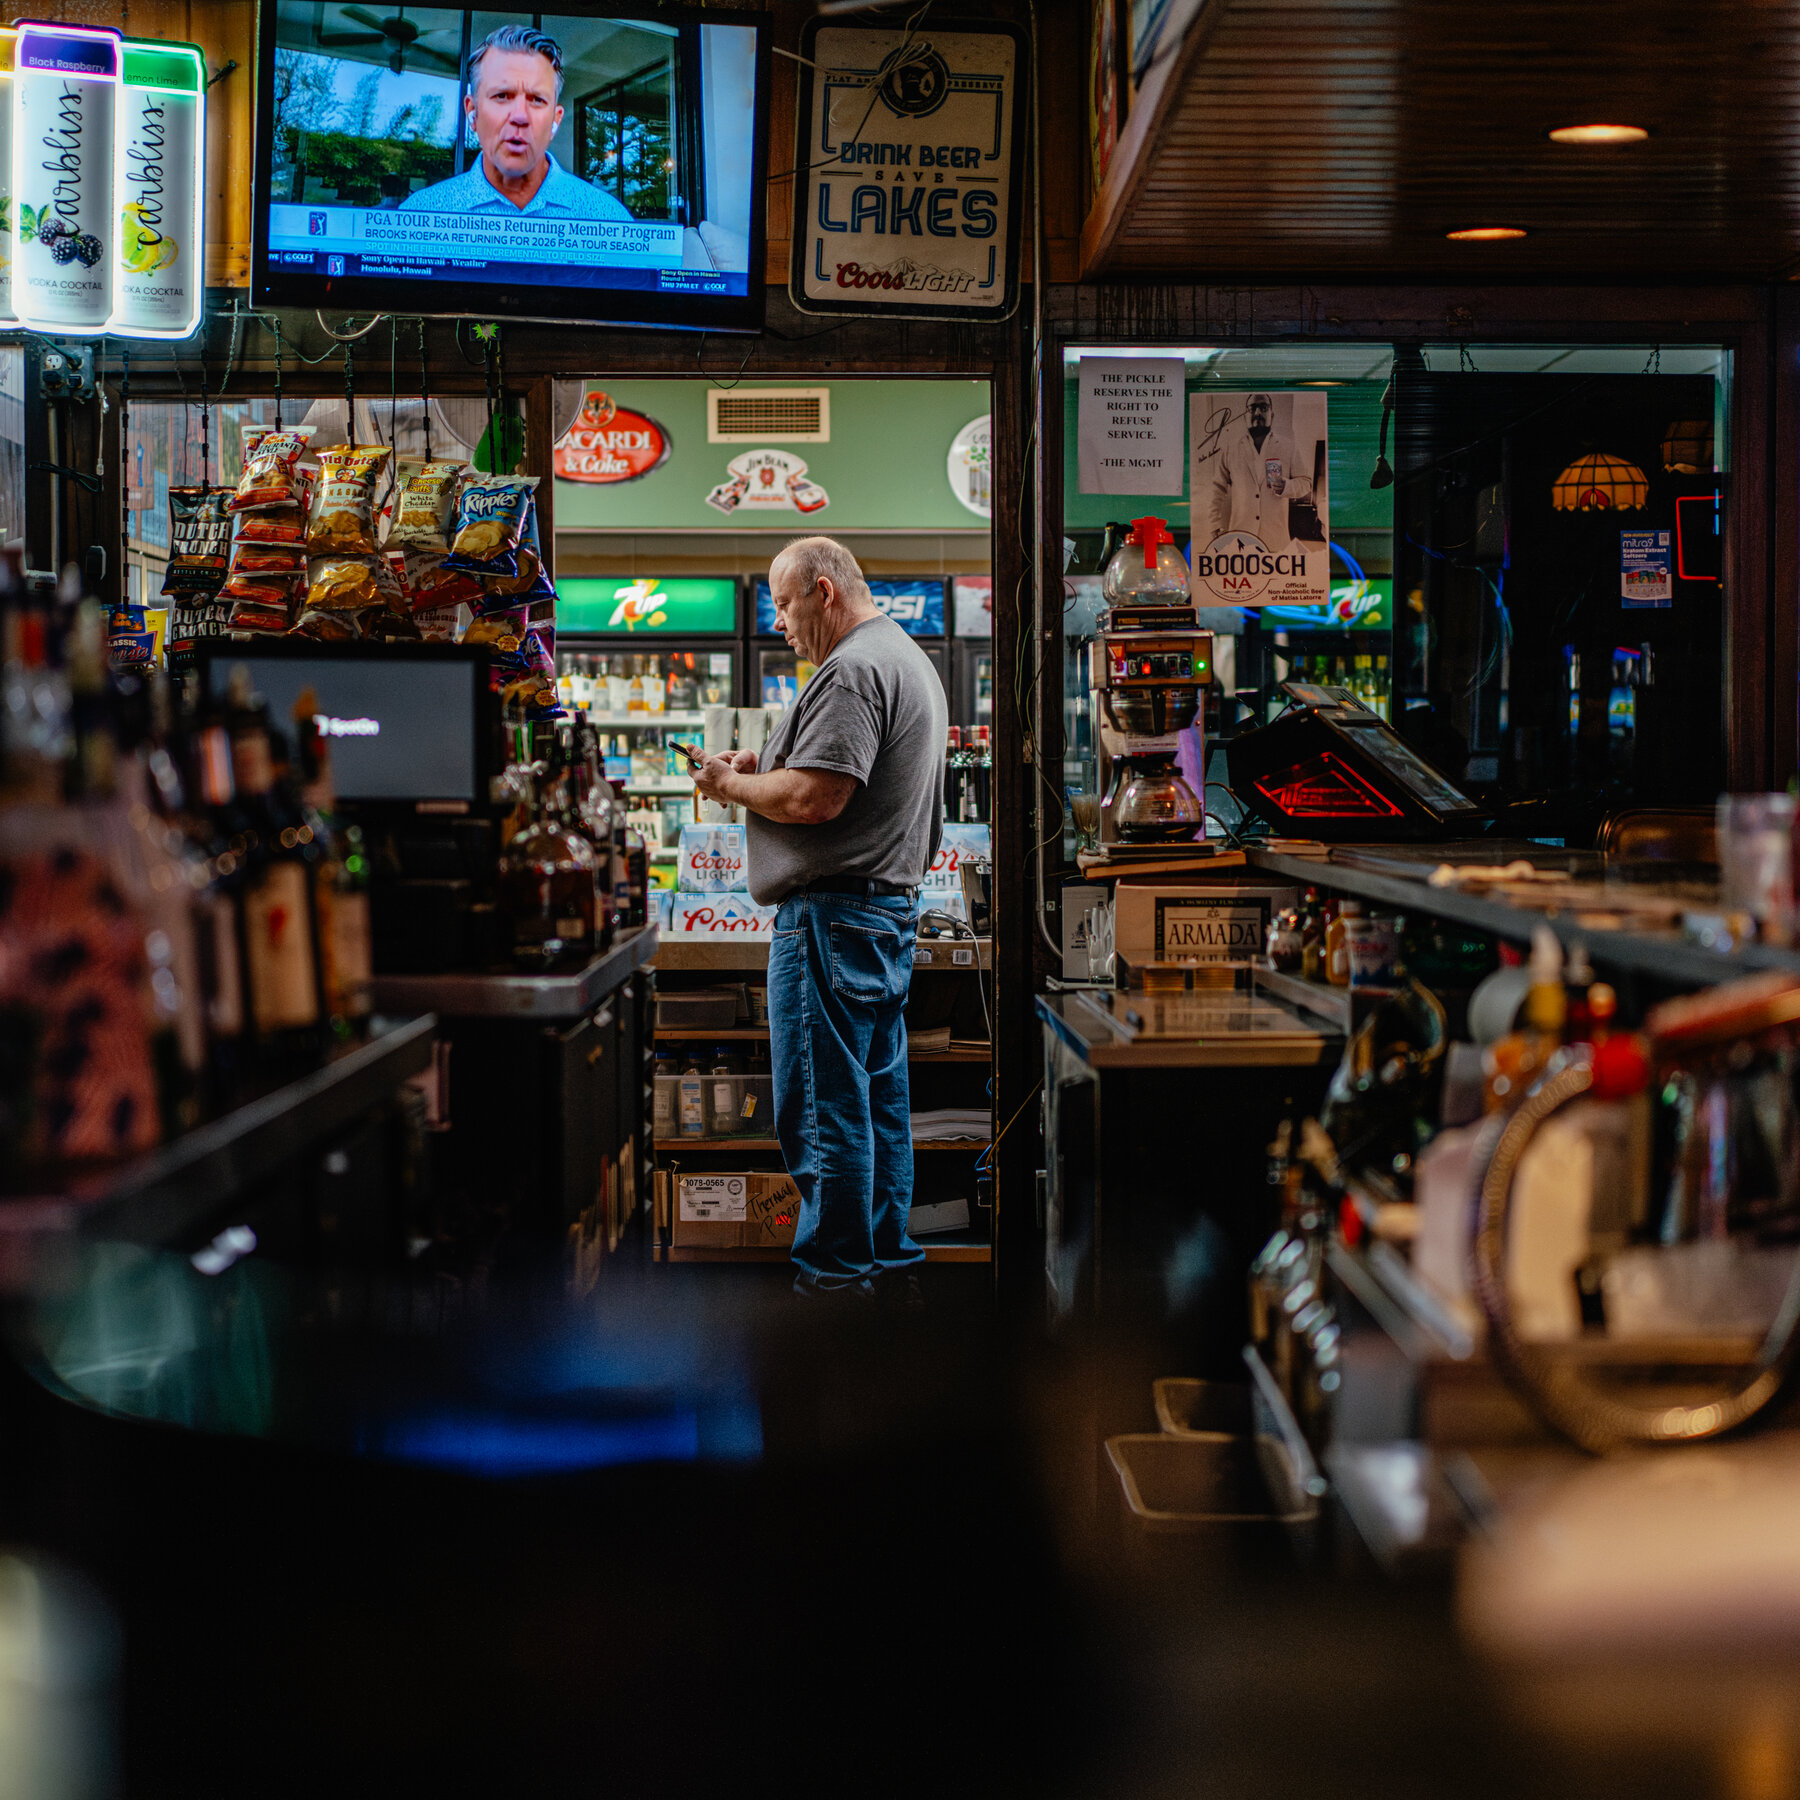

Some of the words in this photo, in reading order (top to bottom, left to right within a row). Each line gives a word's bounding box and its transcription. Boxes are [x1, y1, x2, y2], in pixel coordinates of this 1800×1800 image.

[29, 56, 54, 68] Black
[56, 58, 106, 74] Raspberry
[156, 76, 178, 86] Lime
[840, 142, 912, 167] DRINK
[919, 146, 980, 168] BEER
[875, 170, 944, 184] SAVE
[818, 182, 998, 238] LAKES
[365, 212, 392, 225] PGA
[395, 214, 430, 227] TOUR
[434, 215, 501, 231] Establishes
[504, 219, 566, 237] Returning
[568, 223, 620, 238] Member
[622, 226, 676, 242] Program
[365, 229, 407, 239] BROOKS
[410, 231, 450, 241] KOEPKA
[451, 233, 508, 244] RETURNING
[510, 237, 529, 246] FOR
[532, 237, 556, 247] 2026
[558, 239, 578, 249] PGA
[581, 240, 608, 250] TOUR
[610, 242, 650, 252] SEASON
[361, 254, 381, 264] Sony
[383, 255, 405, 264] Open
[416, 257, 445, 265] Hawaii
[452, 258, 488, 268] Weather
[366, 242, 389, 251] SPOT
[391, 243, 400, 251] IN
[401, 243, 419, 252] THE
[421, 244, 444, 253] FIELD
[446, 246, 470, 255] WILL
[471, 247, 482, 255] BE
[484, 248, 546, 259] INCREMENTAL
[547, 251, 558, 259] TO
[560, 252, 585, 260] FIELD
[586, 253, 605, 262] SIZE
[361, 264, 401, 274] Honolulu,
[403, 266, 432, 275] Hawaii
[836, 262, 905, 290] Coors
[903, 270, 976, 293] LIGHT
[60, 280, 103, 291] COCKTAIL
[143, 286, 184, 297] COCKTAIL
[1101, 374, 1123, 383] THE
[1126, 374, 1166, 384] PICKLE
[1094, 388, 1148, 397] RESERVES
[1151, 388, 1172, 397] THE
[1106, 402, 1140, 411] RIGHT
[1144, 402, 1159, 411] TO
[1112, 416, 1153, 425] REFUSE
[554, 430, 651, 450] ACARDI
[1107, 430, 1156, 440] SERVICE.
[565, 458, 578, 472] &
[580, 453, 628, 474] Coke
[1100, 458, 1126, 467] -THE
[1128, 459, 1164, 468] MGMT
[408, 484, 432, 492] Puffs
[465, 492, 518, 516] Ripples
[174, 520, 230, 540] DUTCH
[172, 539, 229, 557] CRUNCH
[1198, 554, 1306, 578] BOOOSCH
[1223, 577, 1252, 589] NA
[172, 604, 226, 625] DUTCH
[872, 595, 926, 620] PSI
[172, 624, 228, 640] CRUNCH
[689, 851, 742, 870] Coors
[696, 870, 736, 880] LIGHT
[923, 874, 956, 886] GHT
[683, 907, 774, 932] Coor
[1168, 924, 1258, 945] ARMADA
[742, 1181, 794, 1220] Thermal
[760, 1200, 800, 1238] Paper
